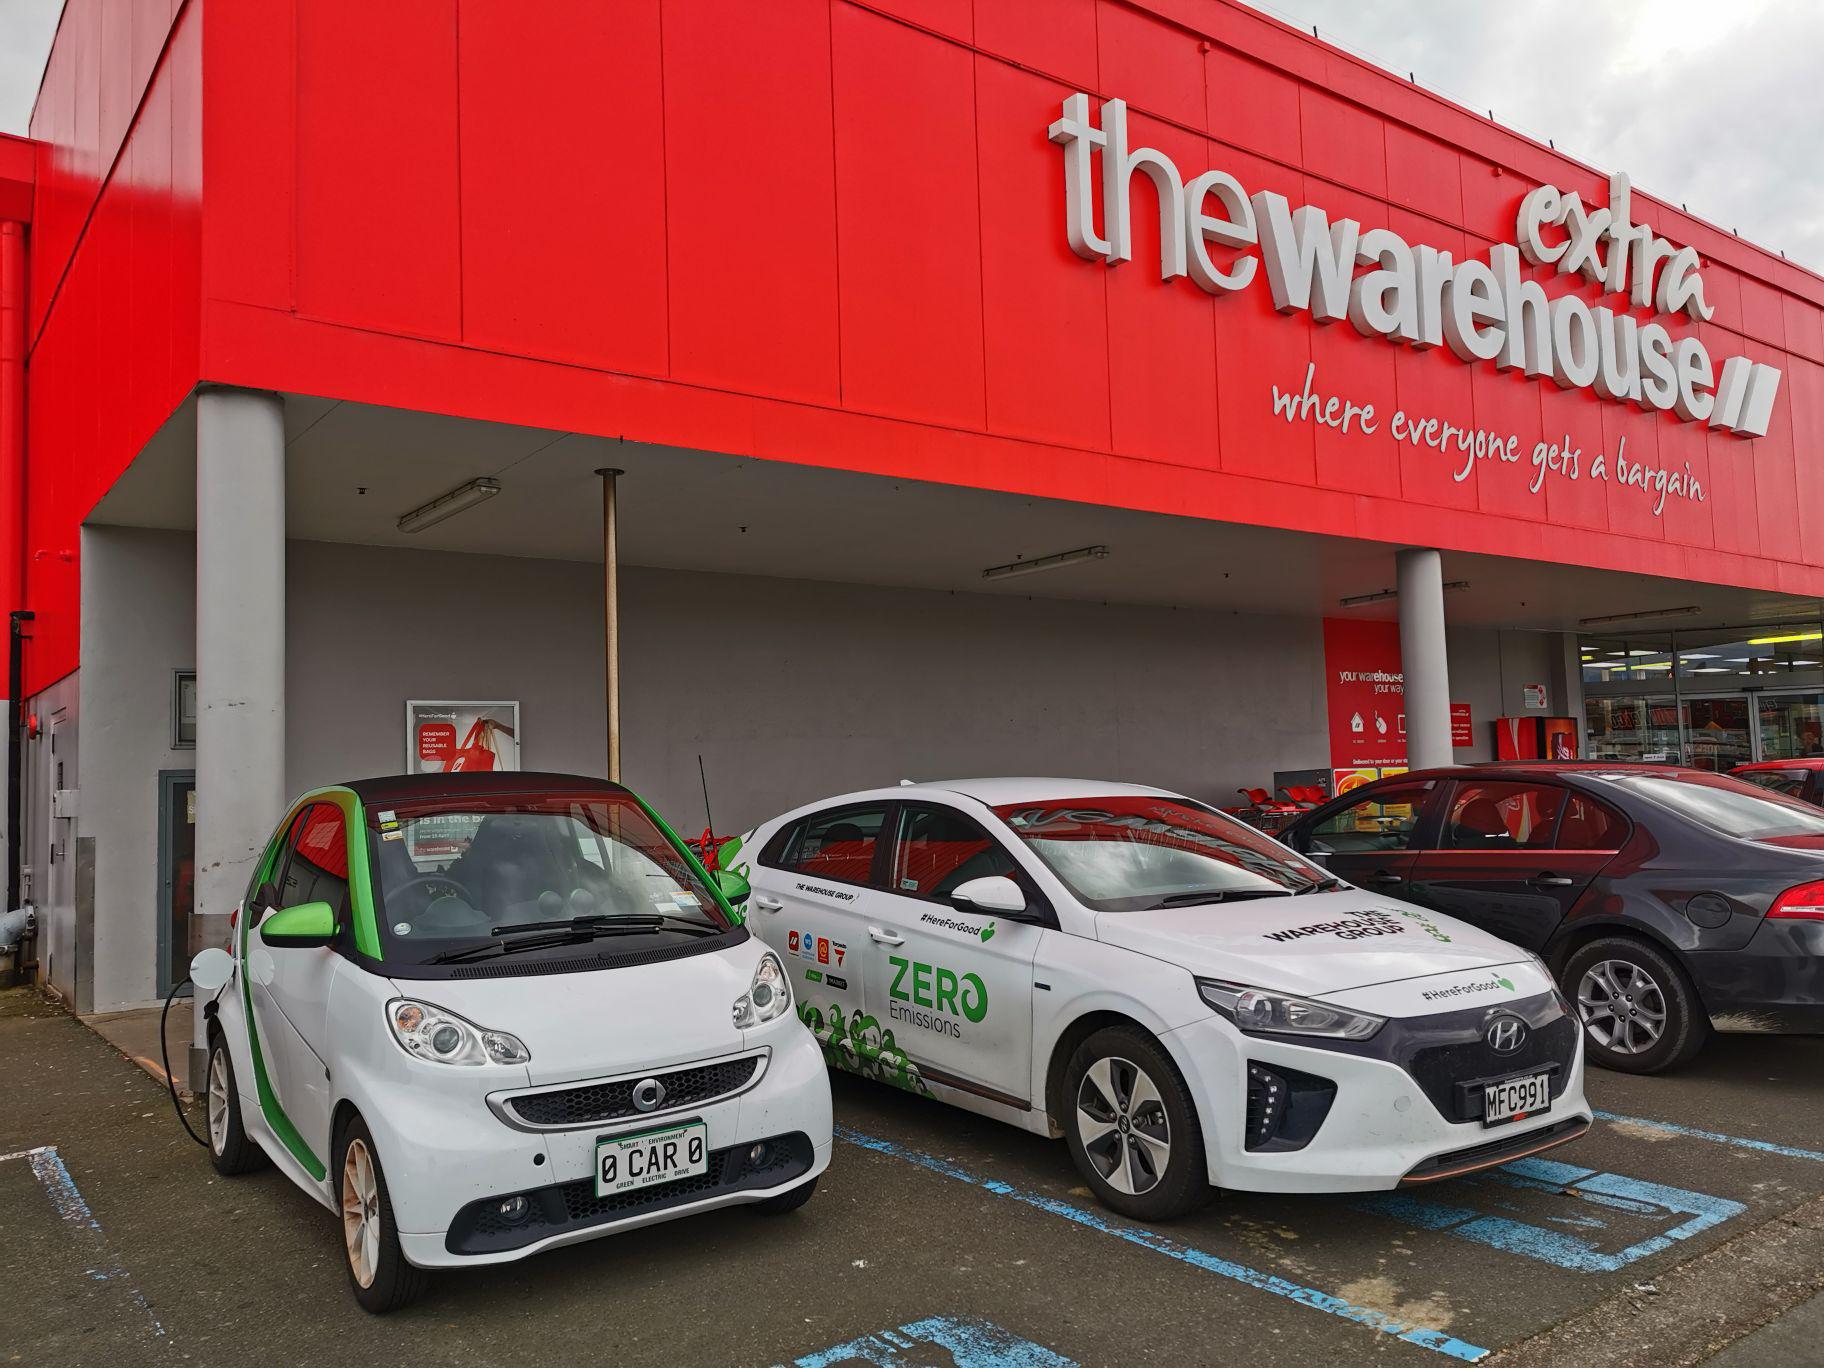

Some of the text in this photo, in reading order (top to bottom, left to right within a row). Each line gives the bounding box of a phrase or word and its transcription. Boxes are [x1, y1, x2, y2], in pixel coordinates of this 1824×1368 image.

[1517, 171, 1715, 322] extra
[1048, 93, 1716, 425] the warehouse
[1272, 362, 1707, 517] where everyone gets a bargain
[1340, 669, 1404, 684] your warehouse
[1374, 684, 1389, 695] your
[447, 815, 469, 824] the
[796, 883, 854, 901] THE WAREHOUSE GROUP
[920, 912, 982, 936] #HereForGood
[1343, 909, 1392, 918] THE
[1262, 916, 1401, 943] WAREHOUSE
[1335, 924, 1406, 941] GROUP
[889, 955, 988, 1024] ZERO
[1421, 979, 1500, 1001] #HereForGood
[890, 999, 961, 1039] Emissions
[1486, 1078, 1546, 1118] MFC991
[616, 1167, 690, 1190] GREEN ELECTRIC DRIVE
